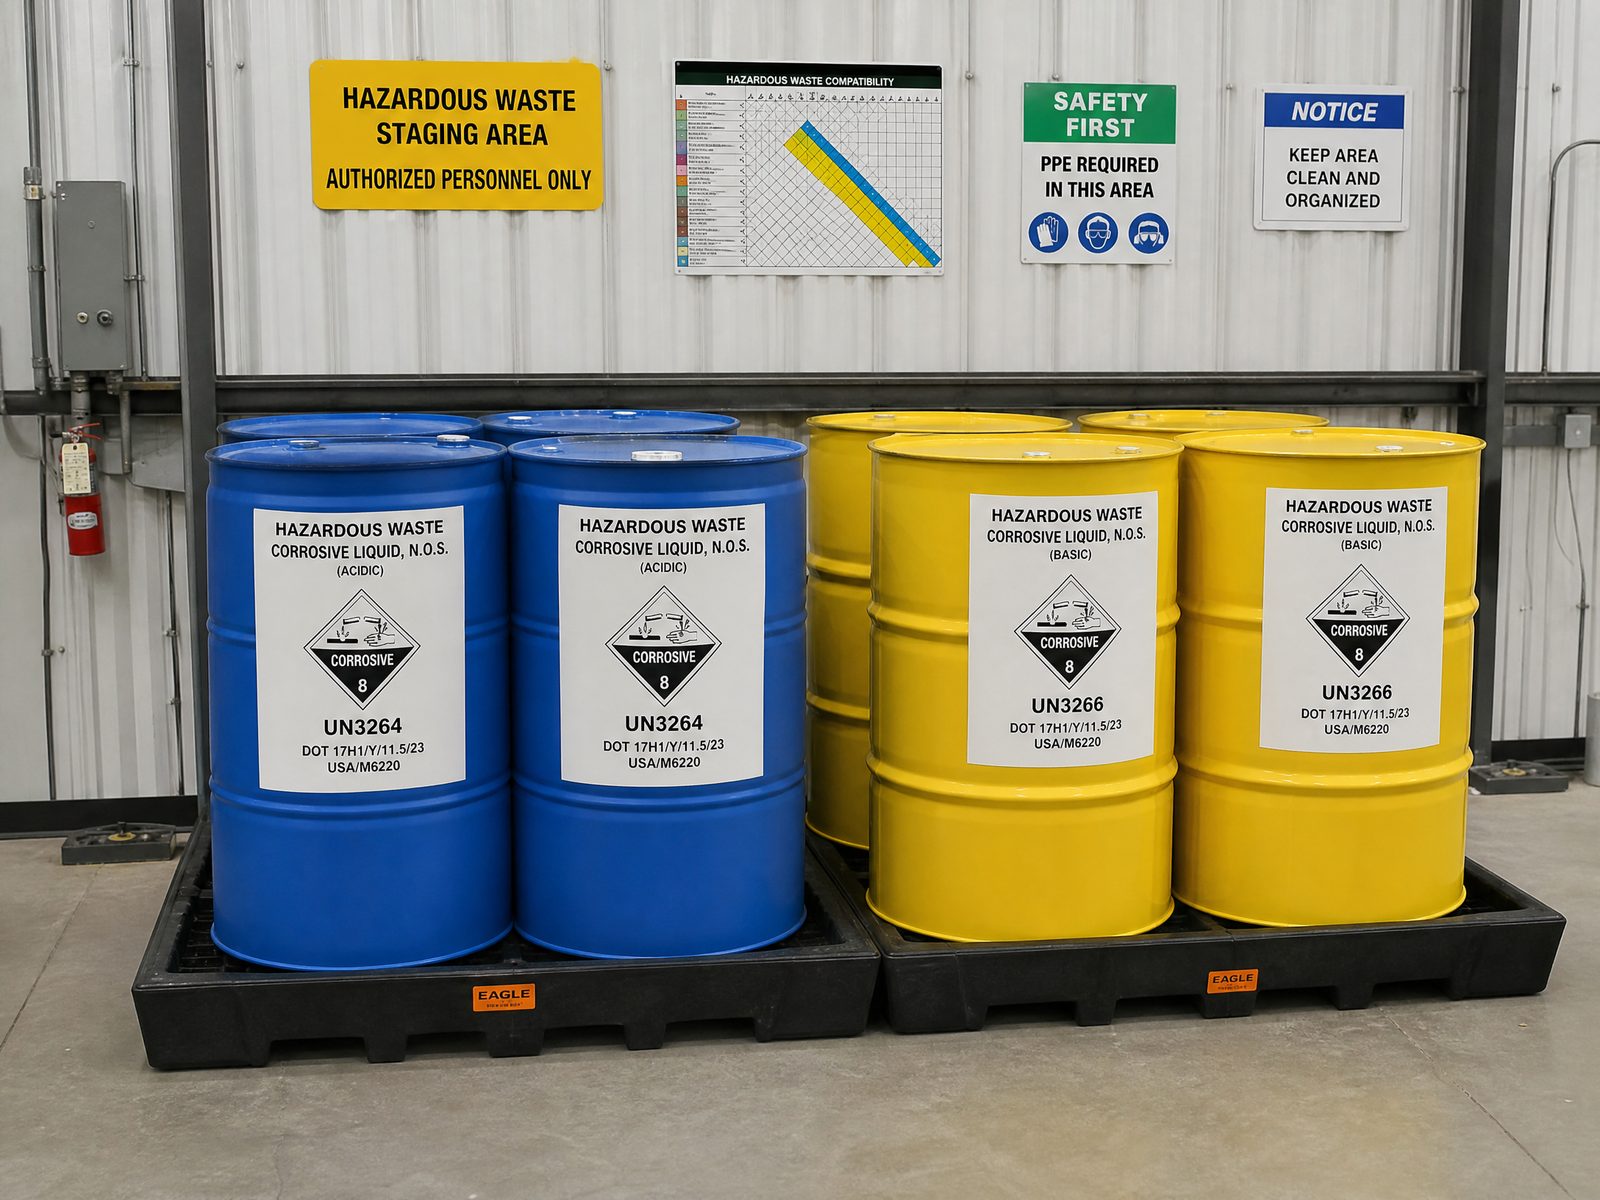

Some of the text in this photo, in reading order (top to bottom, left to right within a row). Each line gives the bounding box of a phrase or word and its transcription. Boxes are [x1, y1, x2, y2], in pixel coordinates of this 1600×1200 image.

[726, 76, 894, 87] HAZARDOUS WASTE COMPATIBILITY
[344, 87, 575, 111] HAZARDOUS WASTE
[1054, 92, 1147, 111] SAFETY
[1292, 102, 1378, 121] NOTICE
[377, 122, 548, 145] STAGING AREA
[1067, 118, 1134, 137] FIRST
[1290, 148, 1378, 162] KEEP AREA
[1042, 156, 1158, 173] PPE REQUIRED
[327, 168, 591, 190] AUTHORIZED PERSONNEL ONLY
[1287, 171, 1380, 185] CLEAN AND
[1046, 182, 1154, 198] IN THIS AREA
[1286, 193, 1380, 207] ORGANIZED
[1287, 499, 1431, 513] HAZARDOUS WASTE
[993, 507, 1142, 522] HAZARDOUS WASTE
[276, 520, 443, 537] HAZARDOUS WASTE
[581, 517, 745, 534] HAZARDOUS WASTE
[1282, 519, 1434, 535] CORROSIVE LIQUID, N.O.S.
[988, 527, 1145, 543] CORROSIVE LIQUID, N.O.S.
[272, 542, 448, 559] CORROSIVE LIQUID, N.O.S.
[576, 539, 749, 556] CORROSIVE LIQUID, N.O.S.
[1341, 540, 1381, 551] (BASIC)
[1050, 549, 1091, 561] (BASIC)
[337, 565, 383, 578] (ACIDIC)
[641, 562, 686, 574] (ACIDIC)
[1331, 624, 1388, 637] CORROSIVE
[1041, 636, 1098, 648] CORROSIVE
[331, 654, 393, 666] CORROSIVE
[633, 651, 695, 663] CORROSIVE
[1355, 648, 1363, 661] 8
[1065, 660, 1074, 673] 8
[358, 679, 367, 692] 8
[660, 676, 669, 689] 8
[1323, 685, 1392, 700] UN3266
[1033, 697, 1103, 713] UN3266
[1302, 708, 1409, 719] DOT 17H1/Y/11.5/23
[325, 718, 402, 735] UN3264
[626, 715, 703, 731] UN3264
[1011, 719, 1121, 733] DOT 17H1/Y/11.5/23
[1325, 724, 1389, 734] USA/M6220
[303, 742, 424, 756] DOT 17H1/Y/11.5/23
[604, 739, 724, 752] DOT 17H1/Y/11.5/23
[1035, 737, 1101, 749] USA/M6220
[328, 760, 400, 773] USA/M6220
[629, 757, 700, 768] USA/M6220
[1212, 974, 1254, 984] EAGLE
[478, 989, 530, 1000] EAGLE
